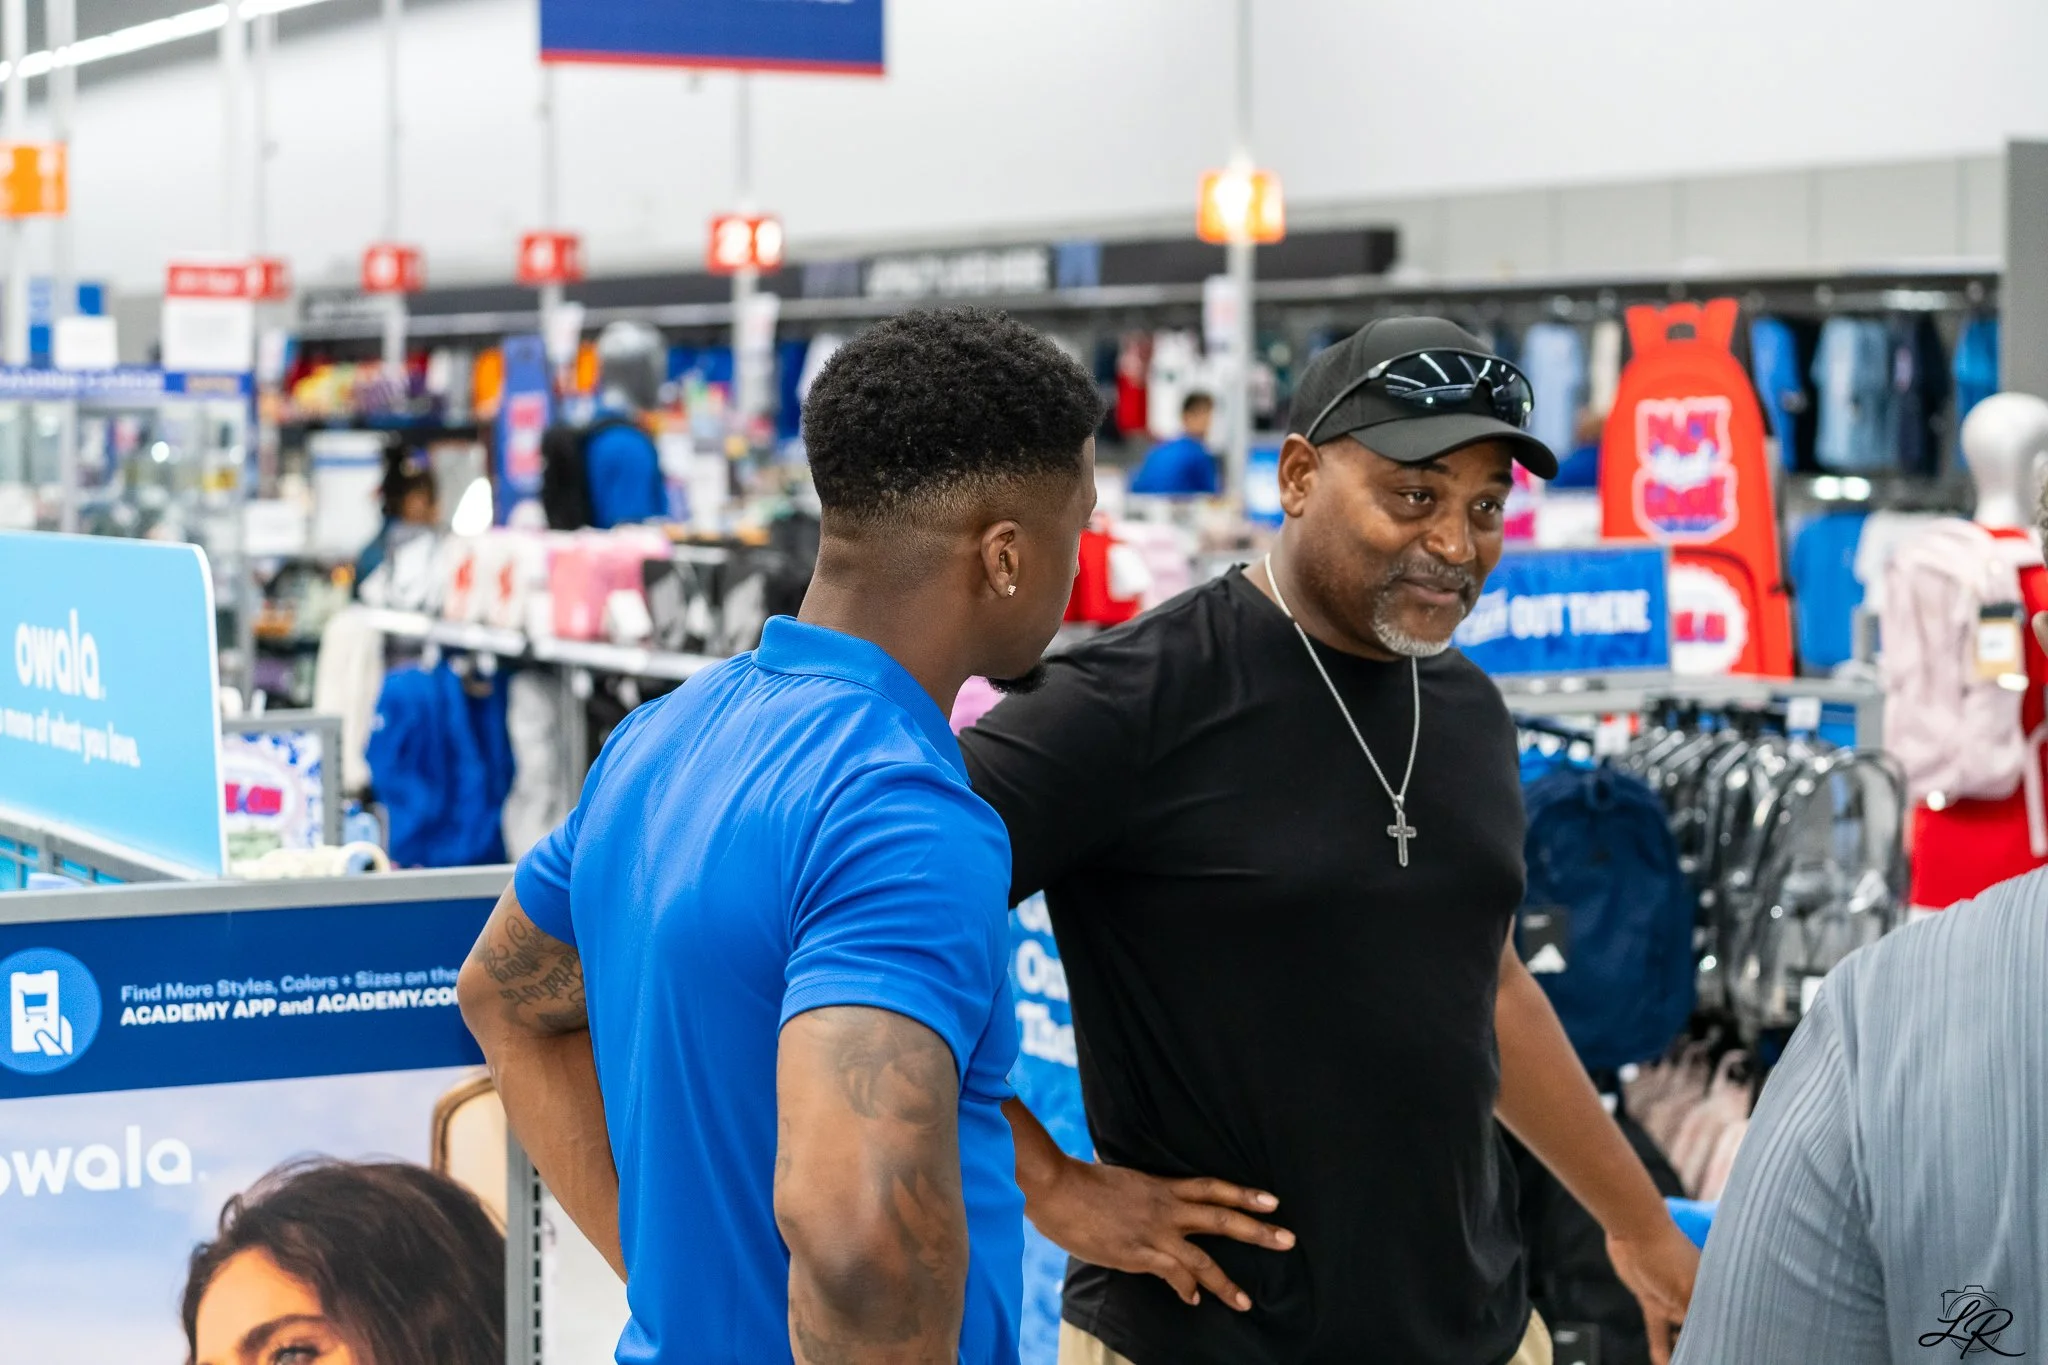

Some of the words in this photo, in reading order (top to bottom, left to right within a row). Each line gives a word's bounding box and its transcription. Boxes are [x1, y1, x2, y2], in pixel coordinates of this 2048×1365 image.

[1510, 593, 1563, 640] OUT
[1567, 589, 1652, 636] THERE
[35, 706, 49, 745] of
[50, 711, 82, 754] what
[82, 726, 108, 765] you
[121, 982, 161, 1003] Find
[165, 982, 214, 1000] More
[217, 977, 278, 999] Styles,
[280, 973, 338, 993] Colors
[355, 970, 403, 989] Sizes
[404, 970, 428, 985] on
[430, 965, 459, 984] the
[120, 1000, 230, 1027] ACADEMY
[232, 997, 278, 1020] APP
[278, 995, 314, 1016] and
[0, 1125, 192, 1197] wala
